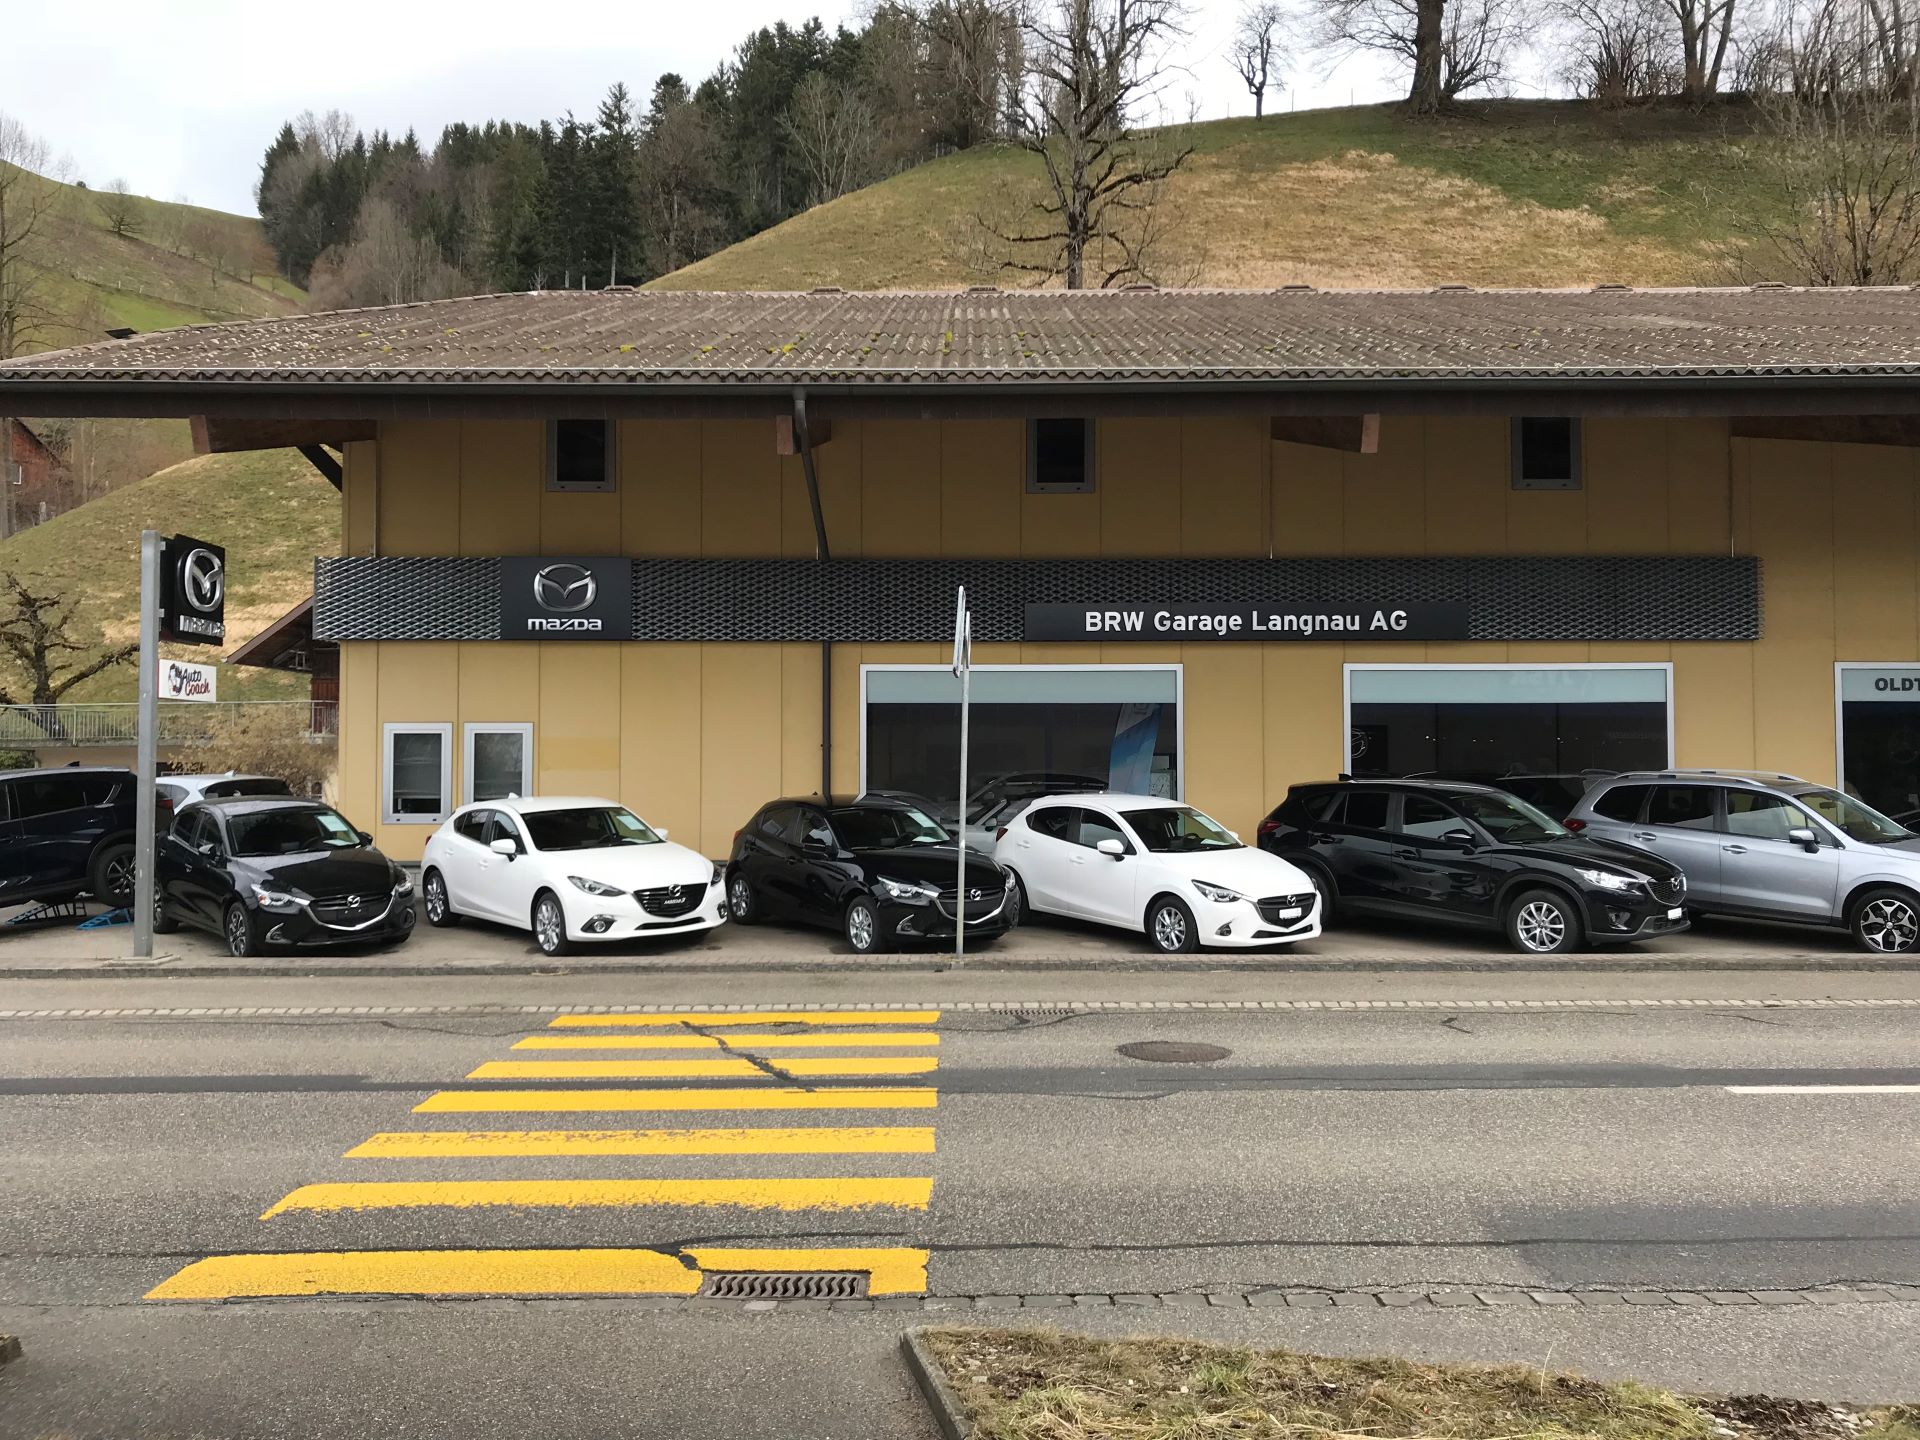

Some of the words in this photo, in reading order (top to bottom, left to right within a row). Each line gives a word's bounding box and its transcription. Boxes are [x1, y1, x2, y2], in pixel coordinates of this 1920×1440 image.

[1085, 611, 1145, 632] BRW
[1153, 611, 1243, 636] Garage
[1252, 610, 1360, 636] Langnau
[1369, 610, 1408, 631] AG
[185, 678, 210, 697] Coach
